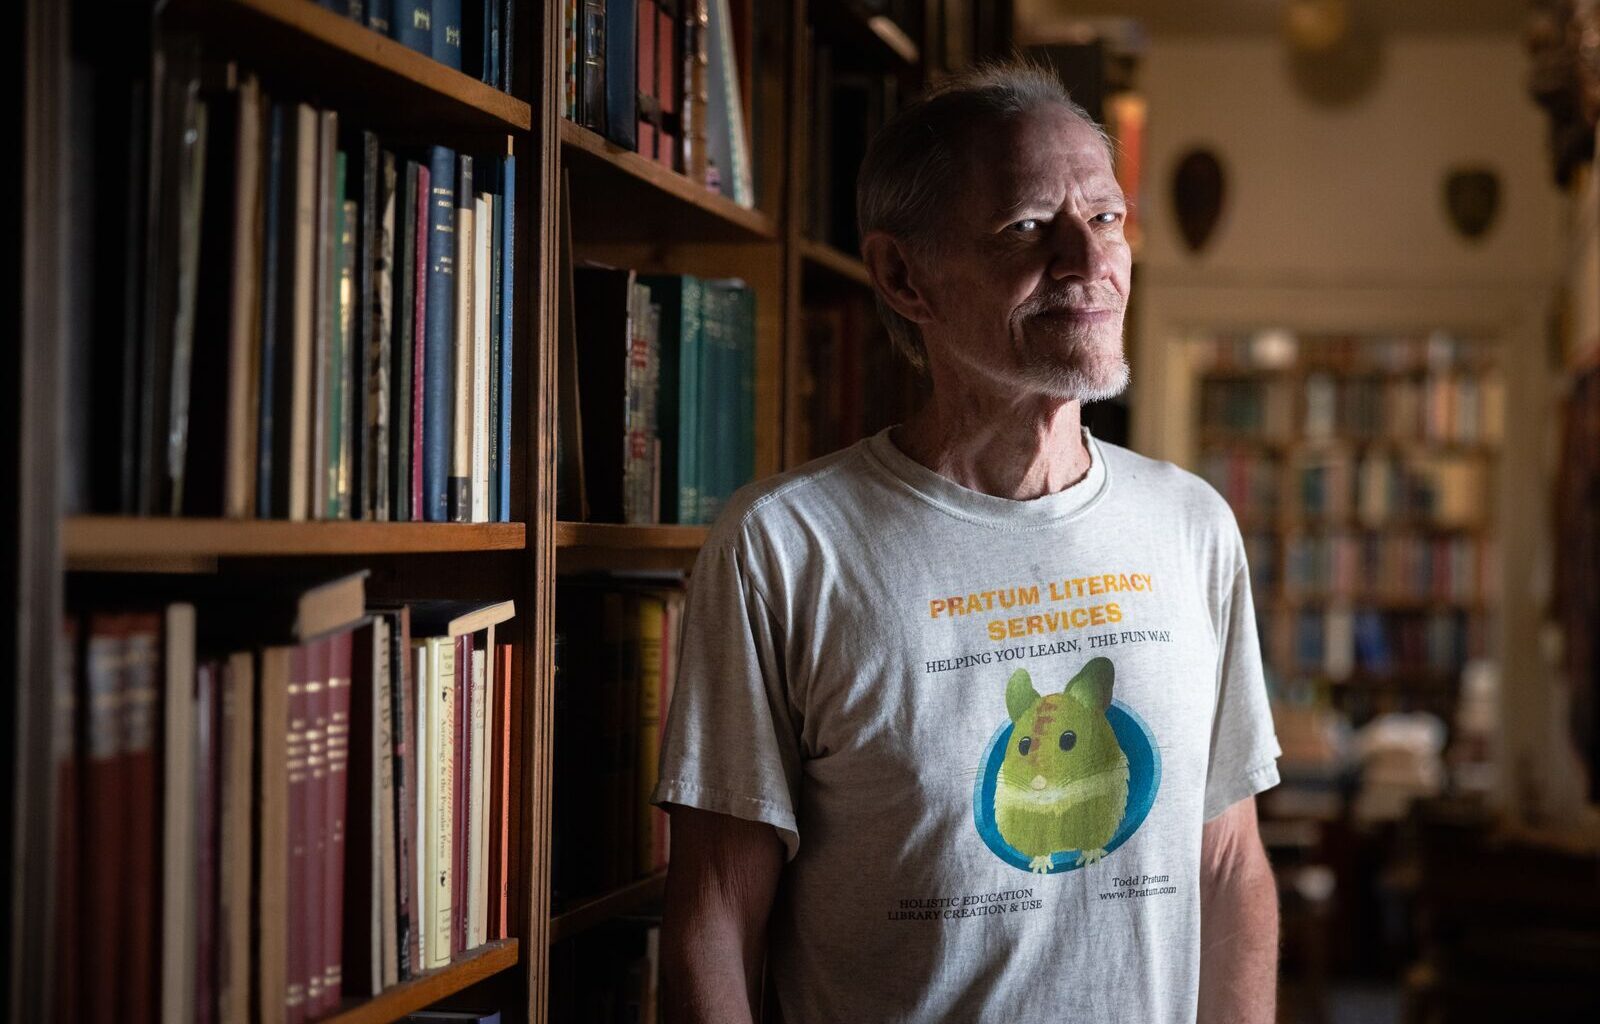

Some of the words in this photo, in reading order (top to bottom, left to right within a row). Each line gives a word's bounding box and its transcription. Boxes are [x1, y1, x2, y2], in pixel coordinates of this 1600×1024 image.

[930, 585, 1040, 619] PRATUM
[1049, 573, 1153, 601] LITERACY
[987, 602, 1122, 641] SERVICES
[926, 653, 992, 673] HELPING
[994, 647, 1025, 662] YOU
[1030, 640, 1082, 658] LEARN,
[1088, 633, 1118, 648] THE
[1121, 630, 1146, 644] FUN
[439, 719, 447, 763] Astrology
[438, 796, 447, 832] Popular
[900, 897, 960, 909] HOLISTIC
[963, 888, 1033, 906] EDUCATION
[1099, 886, 1177, 900] www.Pratum.com
[1112, 875, 1139, 887] Todd
[1142, 874, 1170, 885] Pratum
[888, 910, 940, 921] LIBRARY
[943, 904, 1007, 920] CREATION
[1009, 902, 1019, 913] &
[1021, 899, 1044, 910] USE
